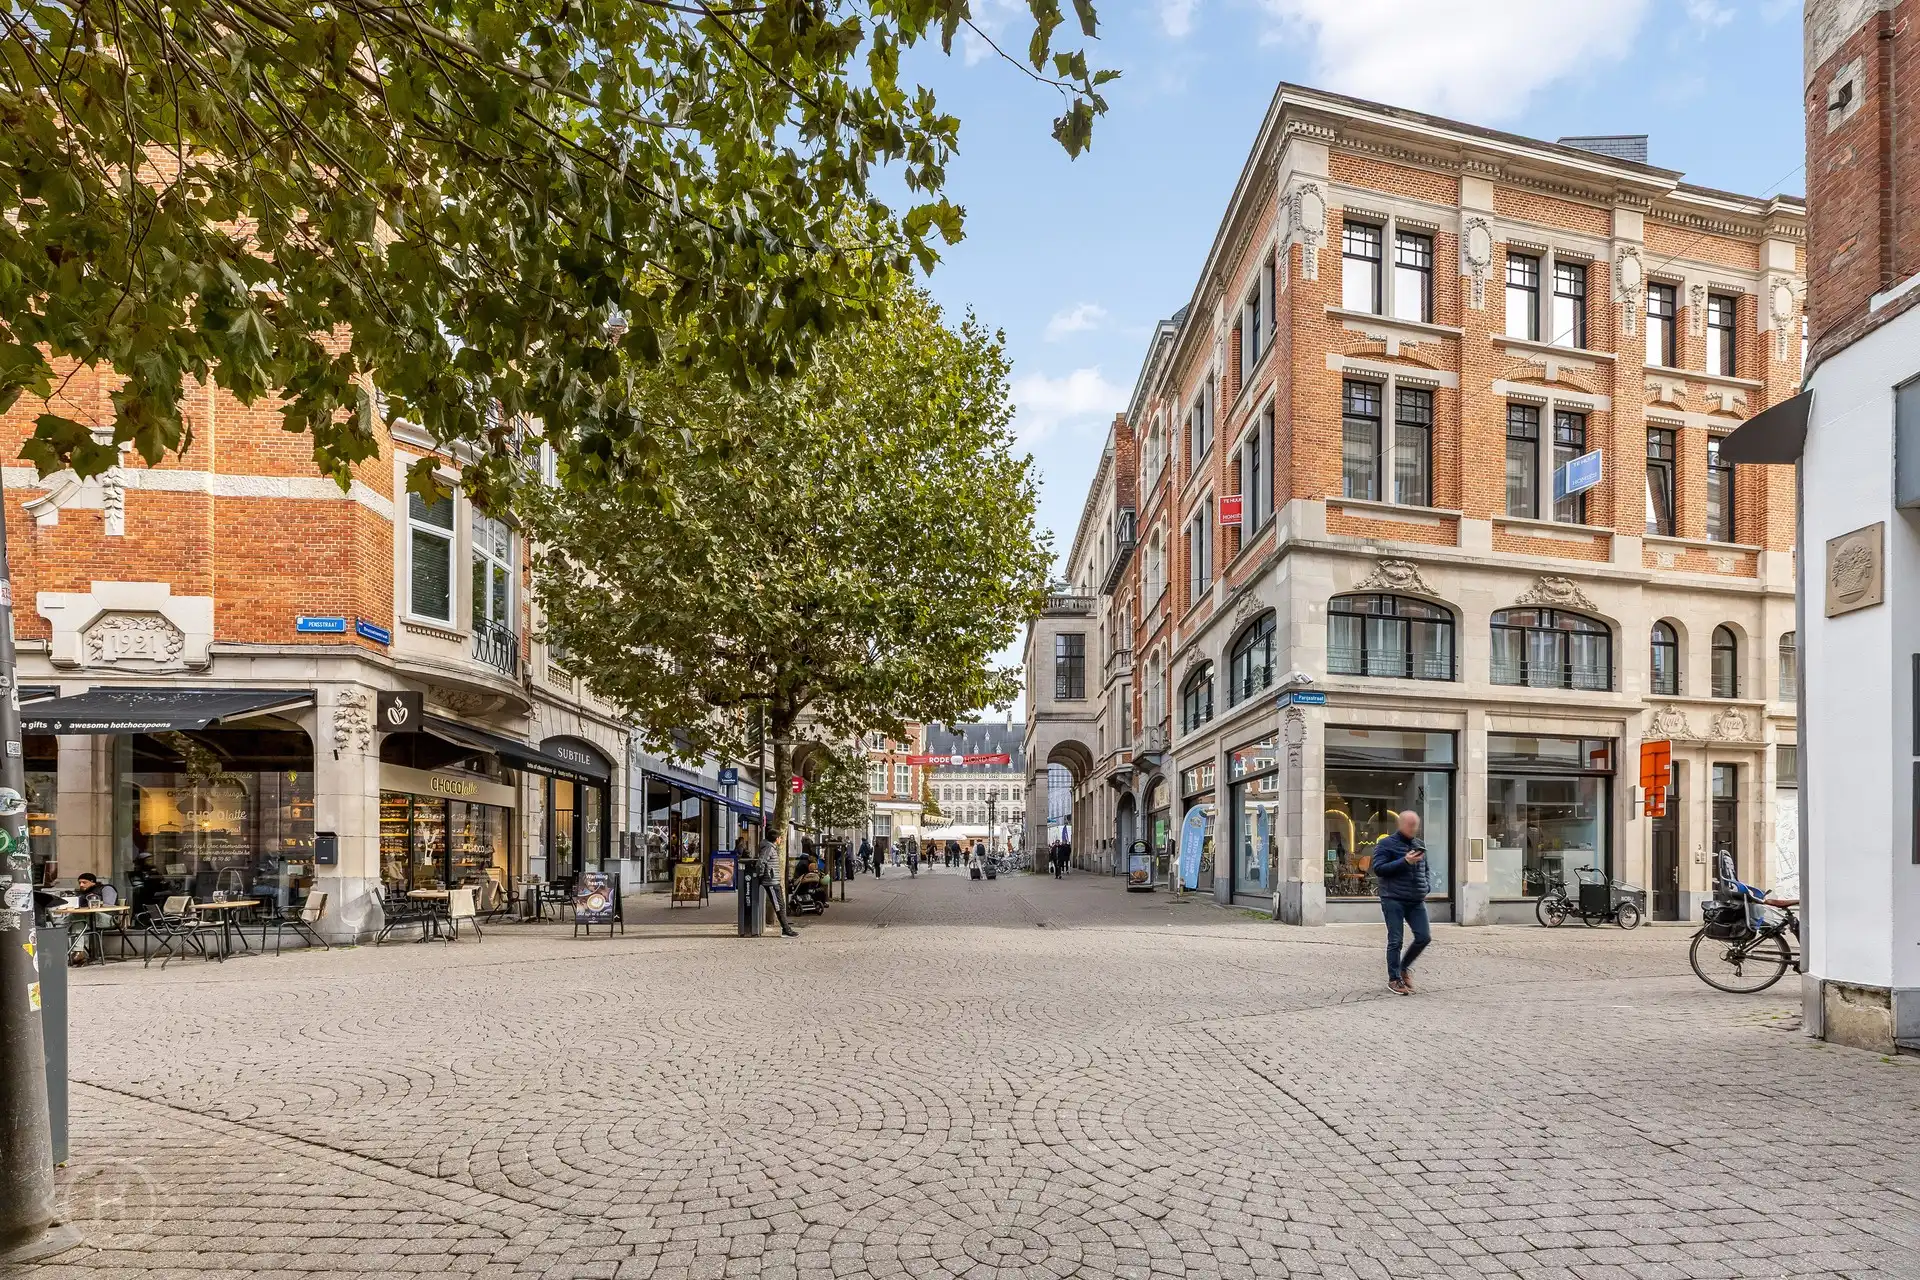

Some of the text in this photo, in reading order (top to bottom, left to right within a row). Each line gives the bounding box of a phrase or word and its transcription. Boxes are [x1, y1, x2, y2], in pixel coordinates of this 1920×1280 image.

[1581, 454, 1597, 465] HUUR
[111, 634, 157, 654] 1921
[28, 720, 48, 730] gifts
[69, 721, 109, 729] awesome
[110, 721, 172, 730] hotchocspoons
[557, 747, 591, 766] SUBTILE
[929, 756, 950, 764] RODE
[430, 776, 479, 798] CHOCOlatte
[586, 872, 608, 880] Warming
